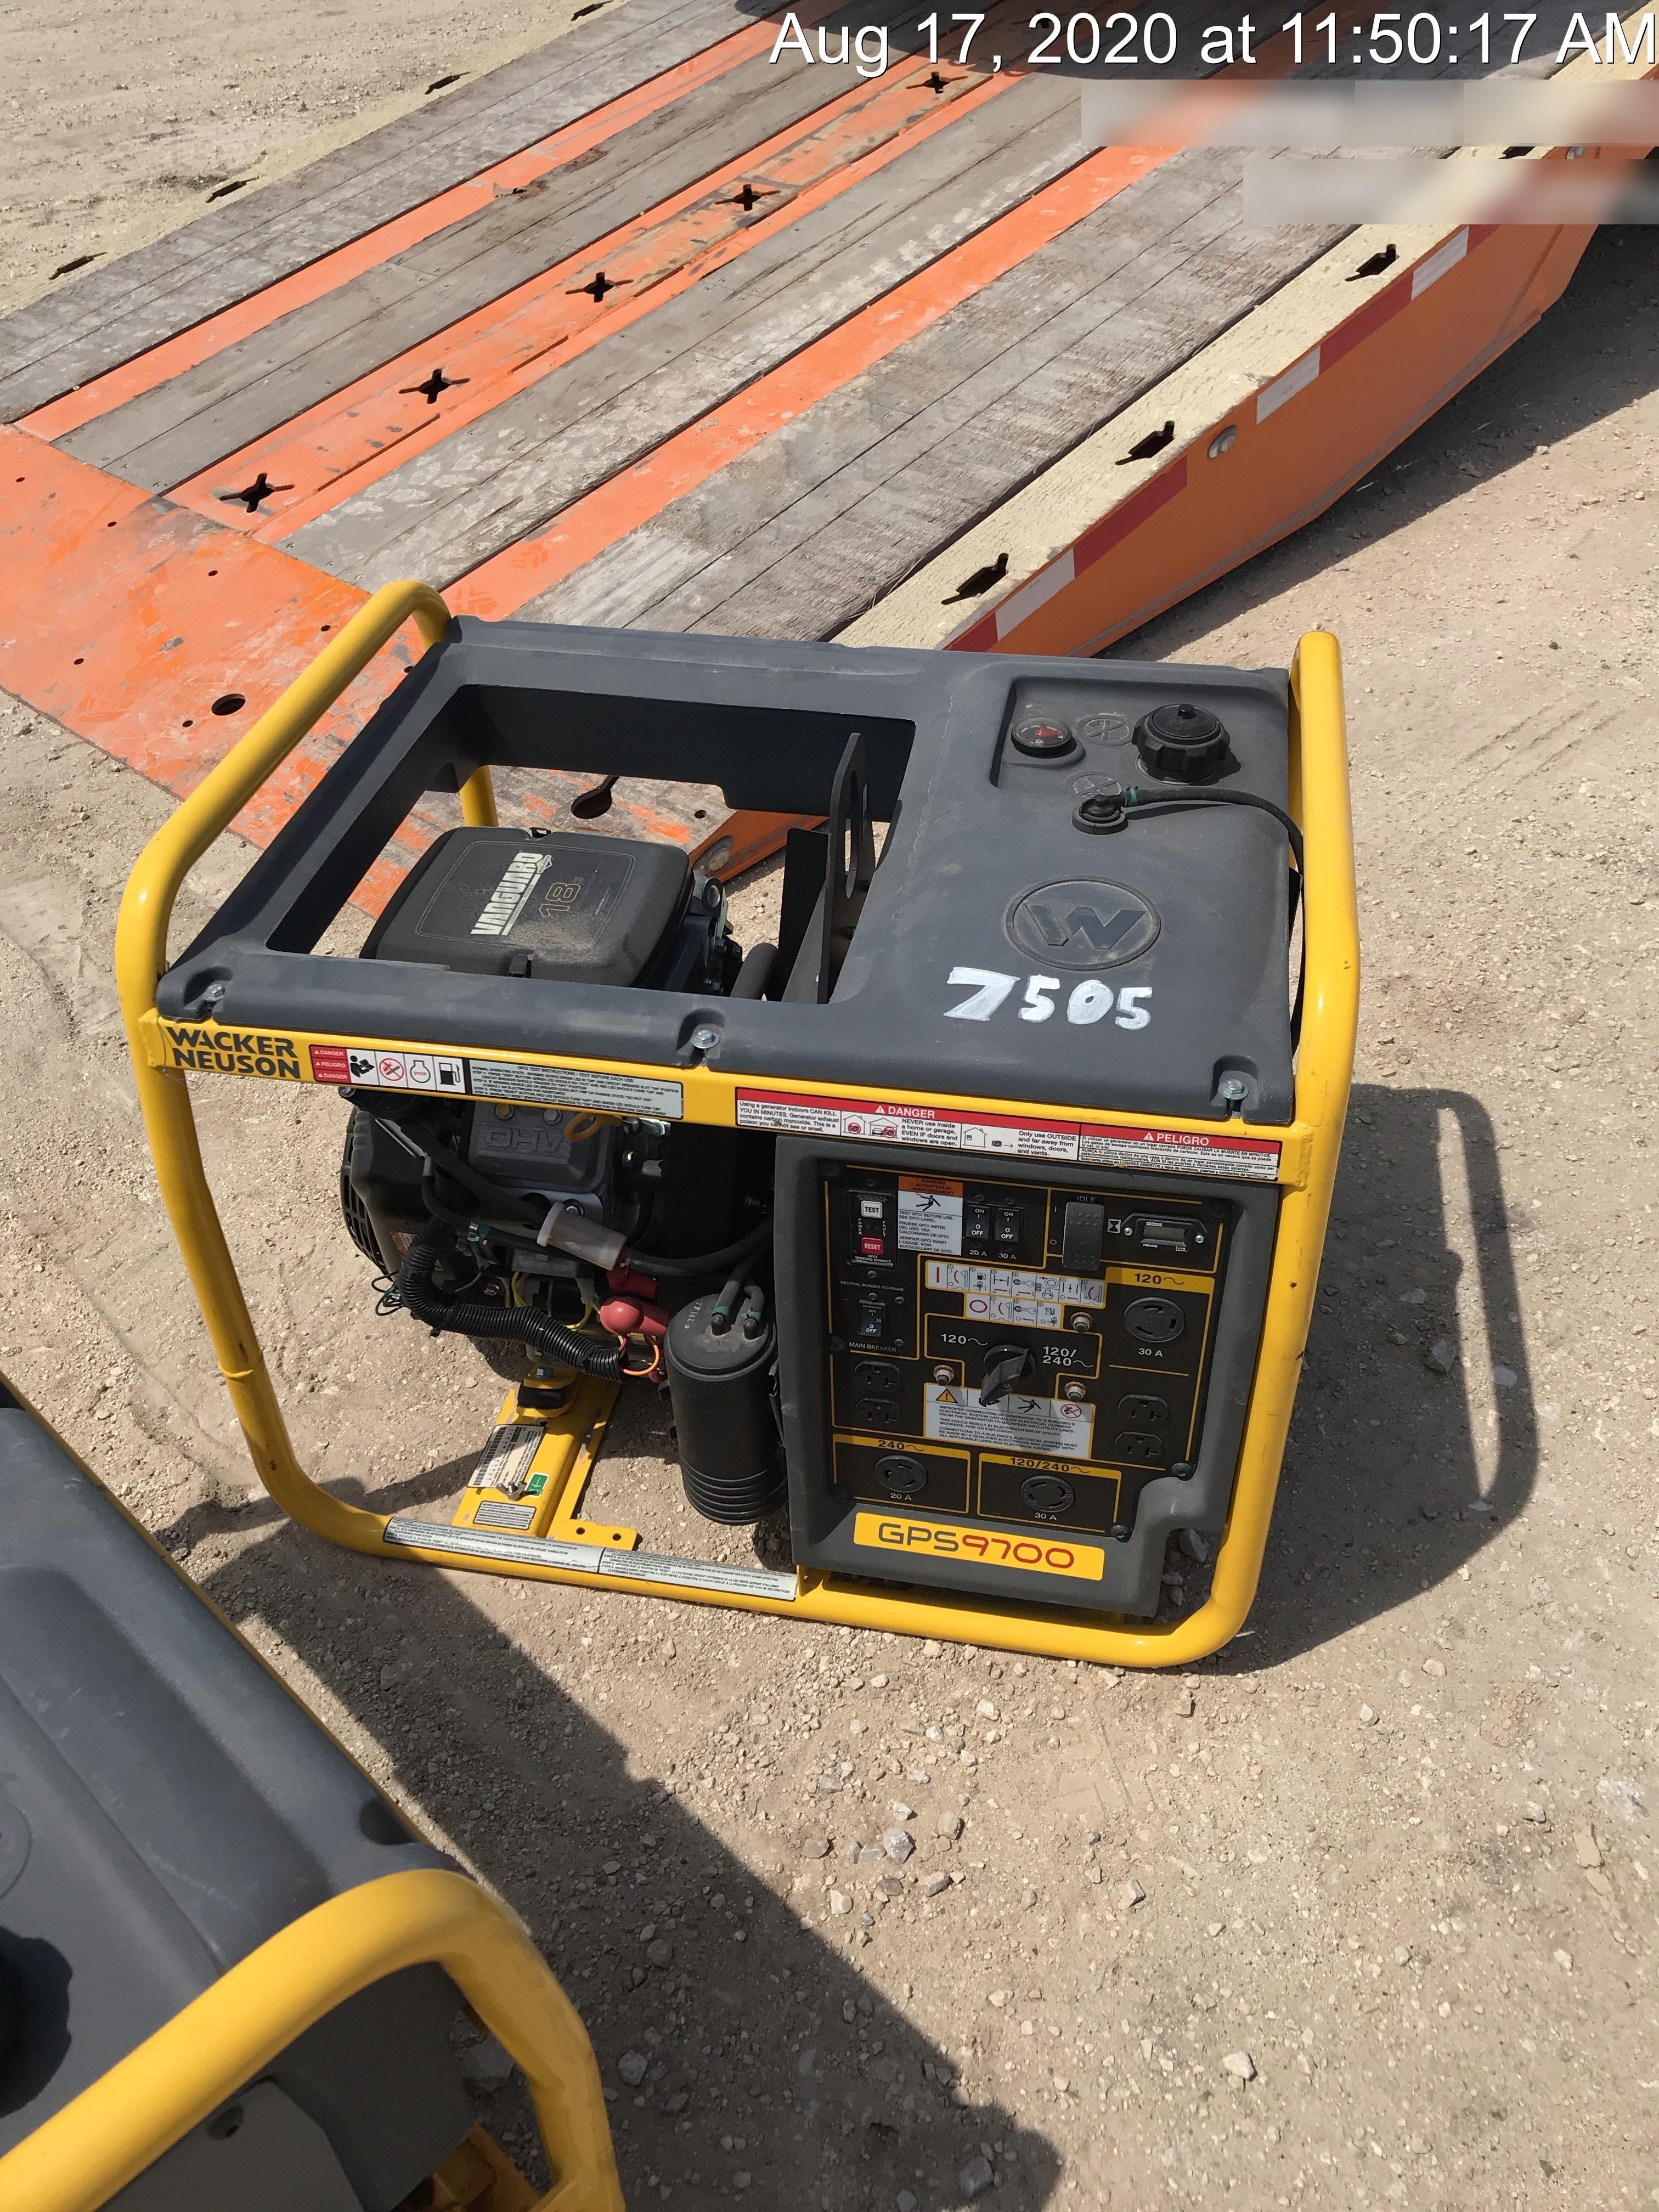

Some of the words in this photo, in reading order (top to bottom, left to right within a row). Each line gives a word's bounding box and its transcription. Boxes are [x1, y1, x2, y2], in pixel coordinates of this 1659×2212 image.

[470, 852, 543, 935] VANGUARD
[538, 882, 582, 918] 18
[943, 966, 1153, 1030] 7505
[166, 1026, 298, 1059] WACKER
[171, 1047, 301, 1079] NEUSON
[321, 1060, 346, 1069] PELIGRO
[323, 1071, 348, 1080] DANGER
[888, 1106, 935, 1119] DANGER
[1156, 1132, 1209, 1146] PELIGRO
[1076, 1195, 1096, 1203] IDLE
[1134, 1273, 1162, 1285] 120
[941, 1333, 967, 1345] 120
[866, 1344, 897, 1352] BREAKER
[1043, 1346, 1077, 1358] 120/
[1138, 1347, 1152, 1356] 30
[1154, 1349, 1163, 1357] A
[1042, 1356, 1072, 1367] 240
[878, 1440, 905, 1451] 240
[1010, 1456, 1069, 1472] 120/240
[1034, 1512, 1047, 1520] 30
[1049, 1513, 1057, 1522] A
[878, 1522, 1074, 1570] GPS9700
